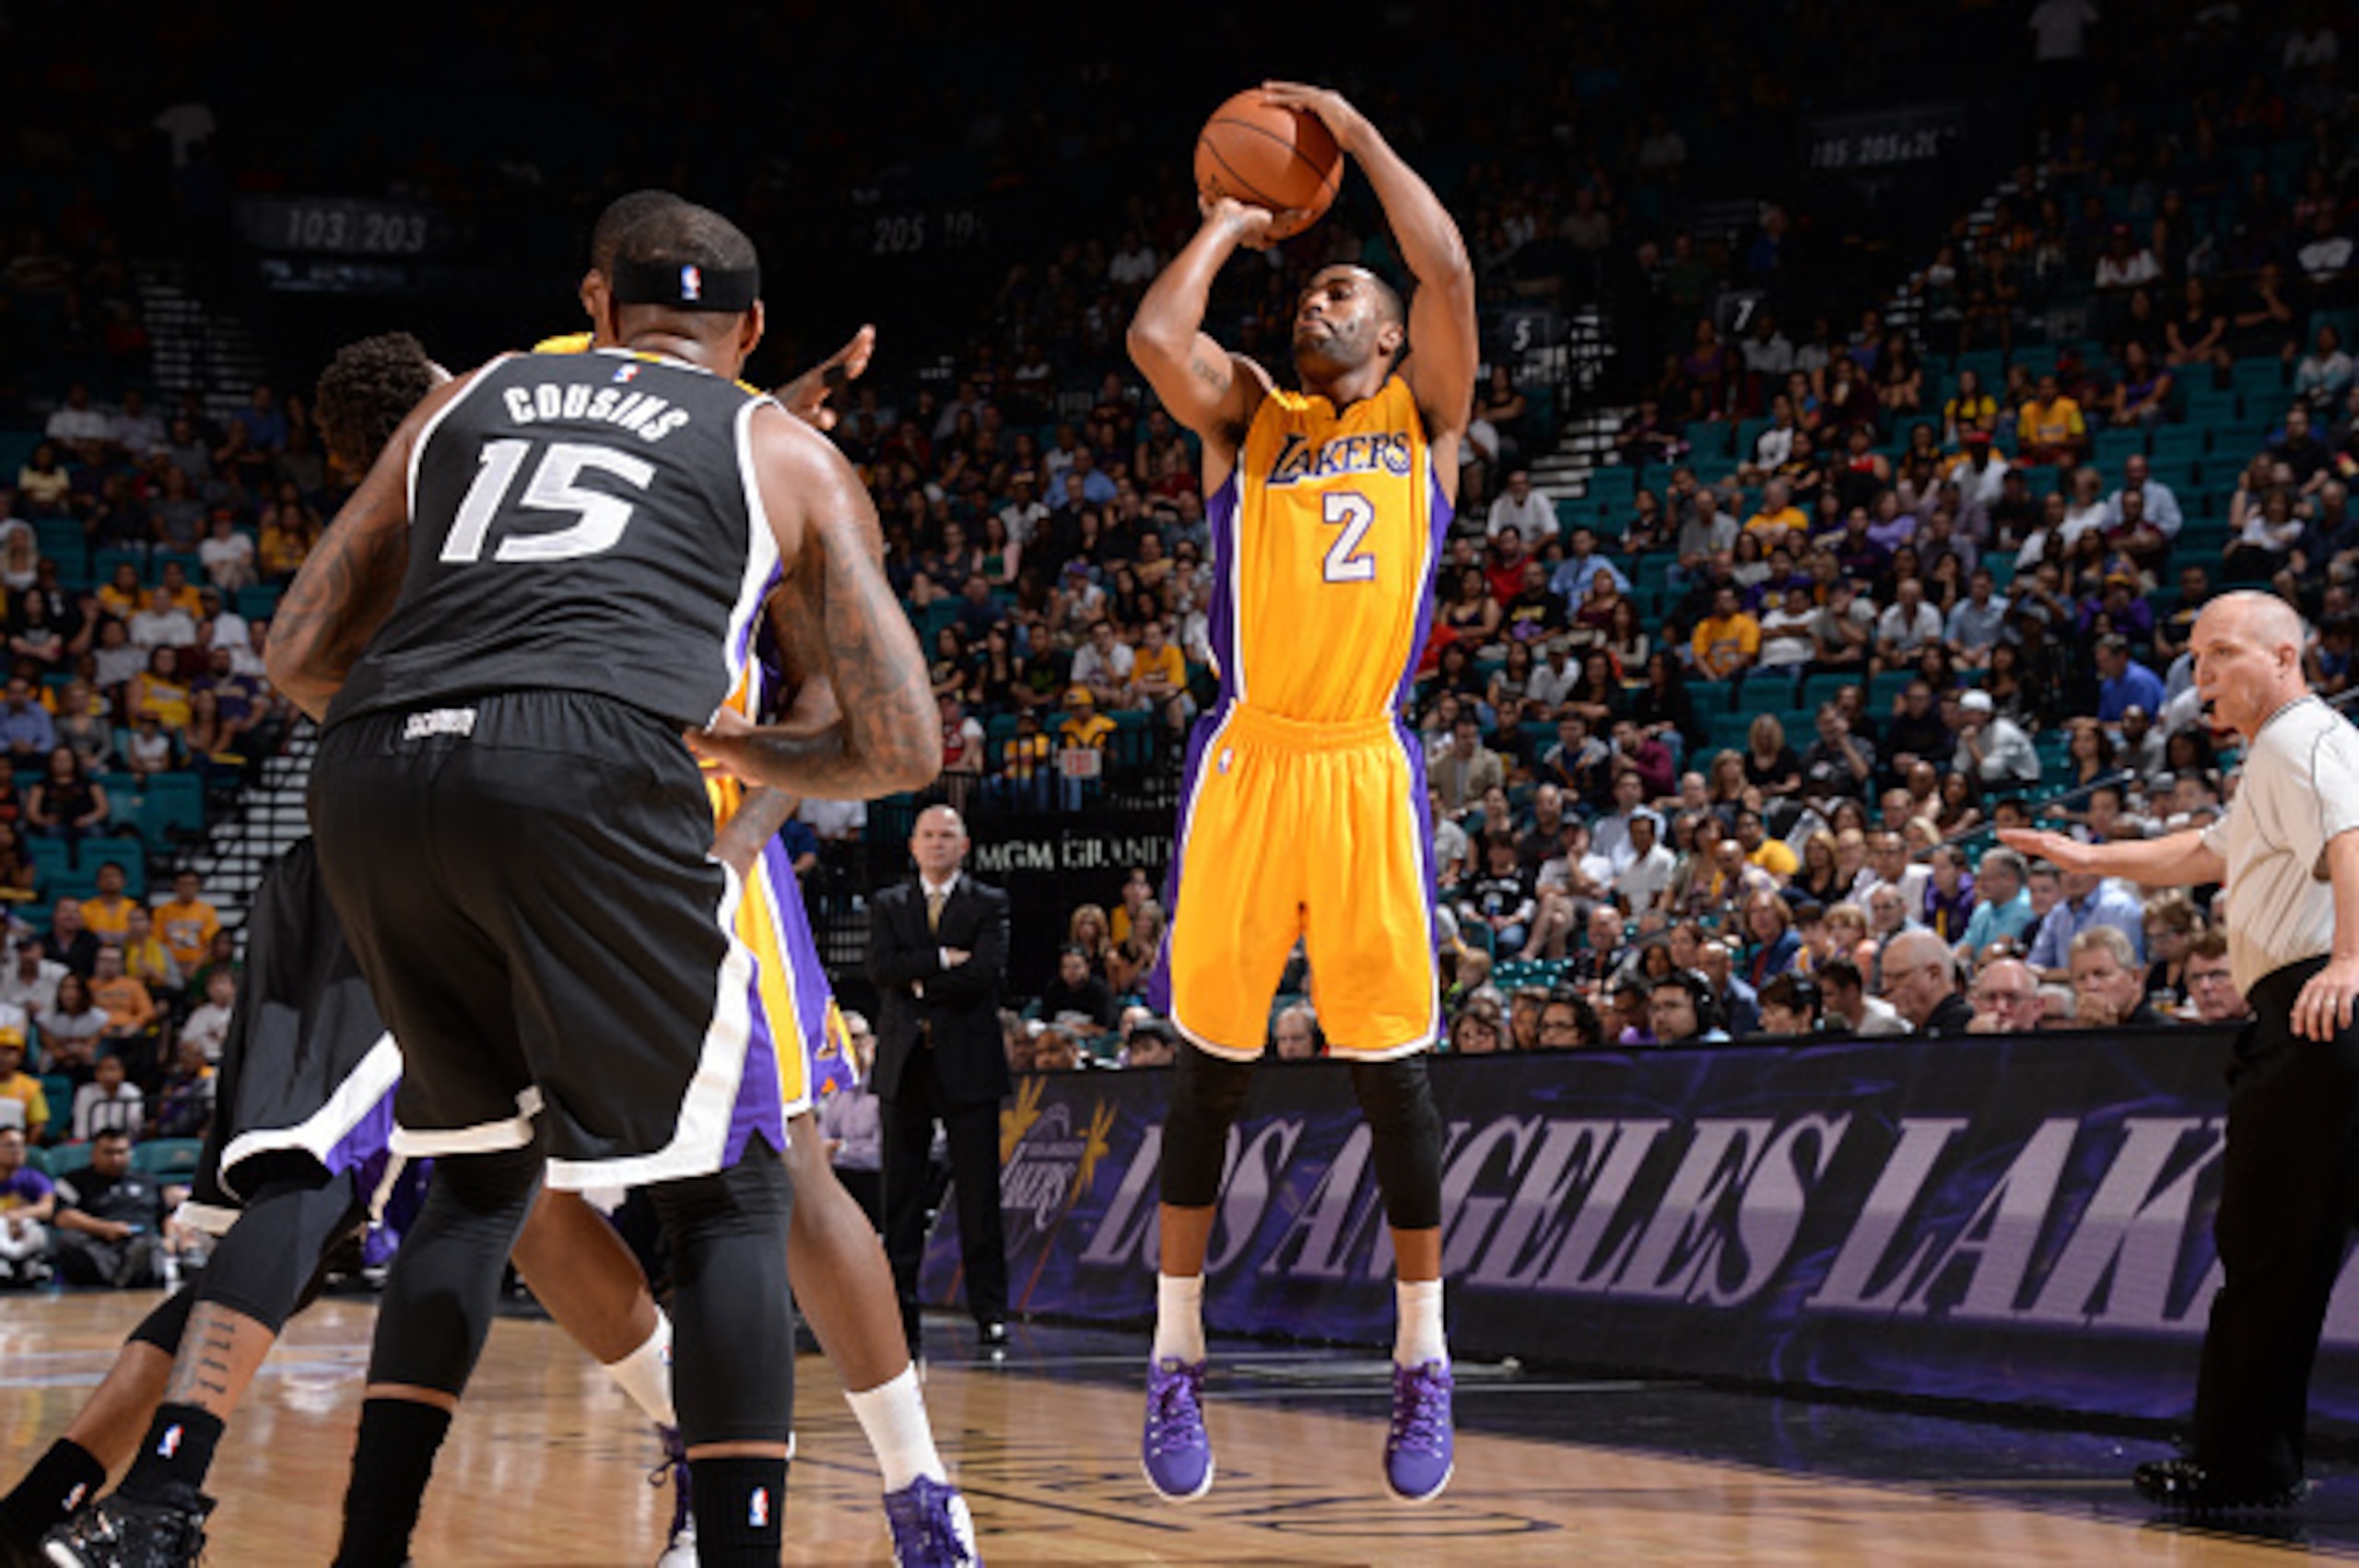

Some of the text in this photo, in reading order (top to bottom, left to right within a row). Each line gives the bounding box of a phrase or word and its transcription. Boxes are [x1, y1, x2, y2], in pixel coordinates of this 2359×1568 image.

[286, 208, 428, 253] 103 203
[873, 213, 927, 256] 205
[502, 382, 691, 444] COUSINS
[1263, 431, 1412, 487] LAKERS
[438, 439, 658, 564] 15
[1321, 490, 1376, 583] 2
[974, 838, 1056, 873] MGM
